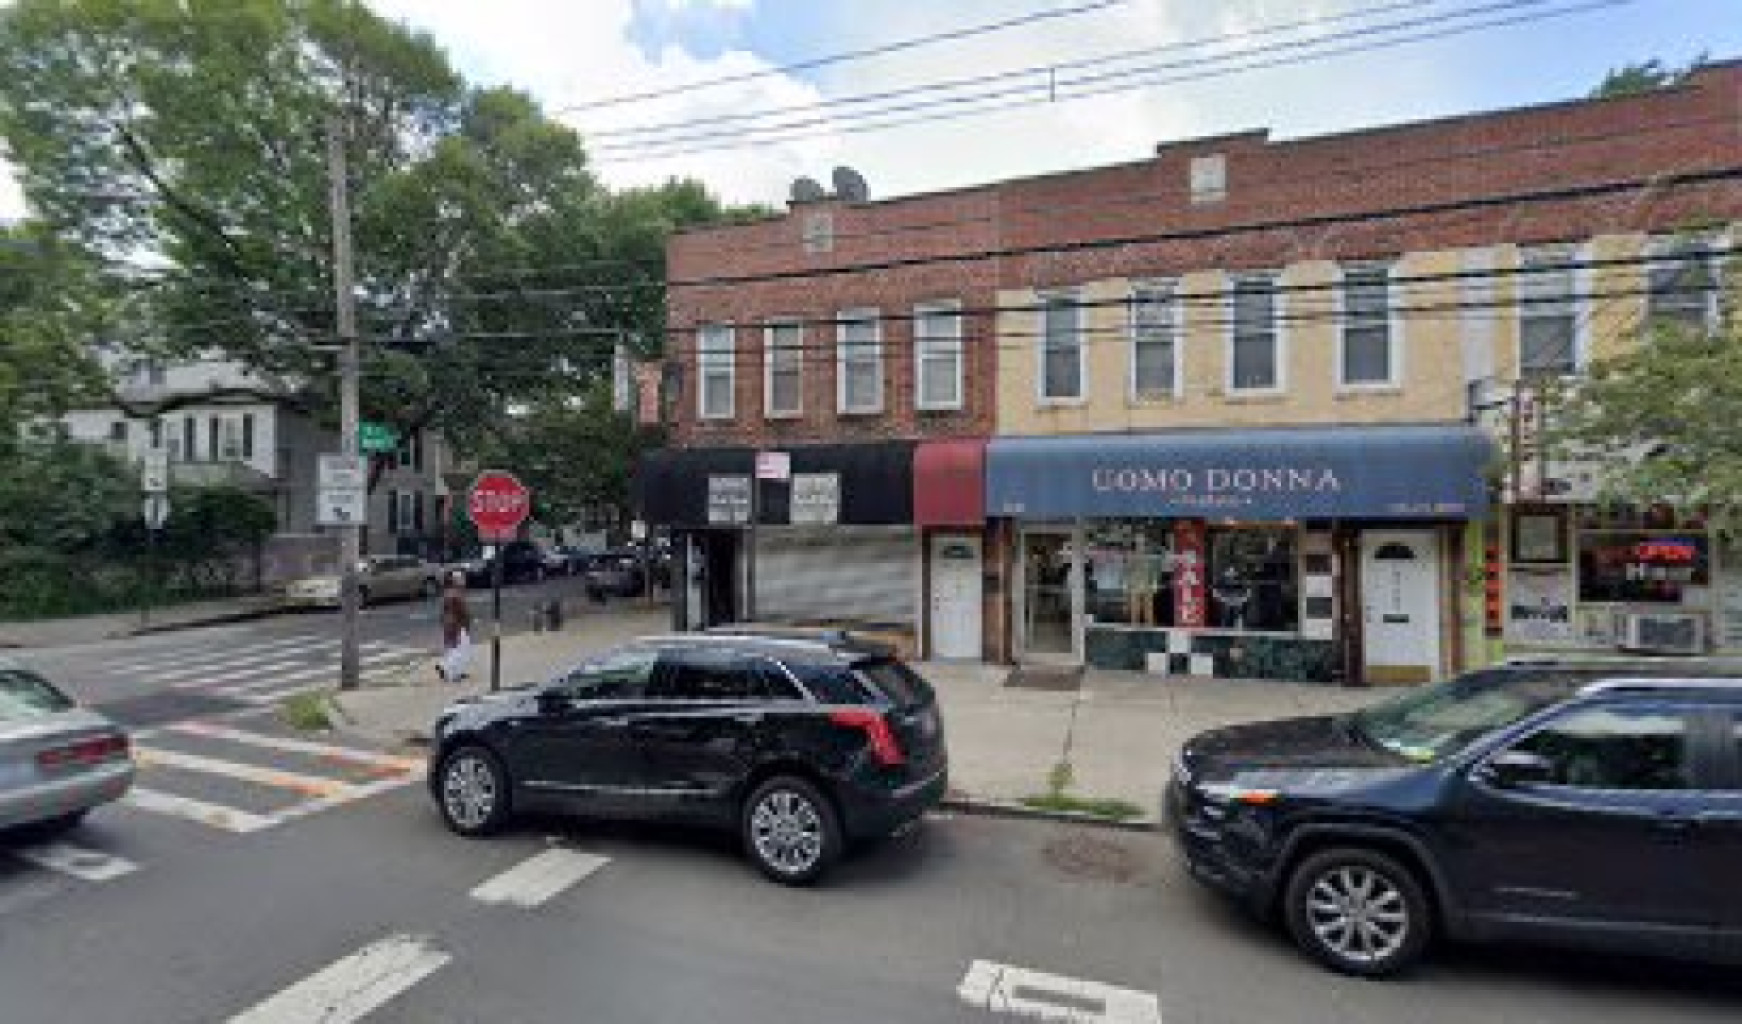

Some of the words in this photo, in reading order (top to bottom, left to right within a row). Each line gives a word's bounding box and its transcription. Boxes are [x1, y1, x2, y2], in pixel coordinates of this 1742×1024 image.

[1092, 469, 1193, 491] UOMO
[1207, 468, 1340, 491] DONNA
[472, 489, 525, 512] STOP
[1178, 550, 1202, 625] SALE
